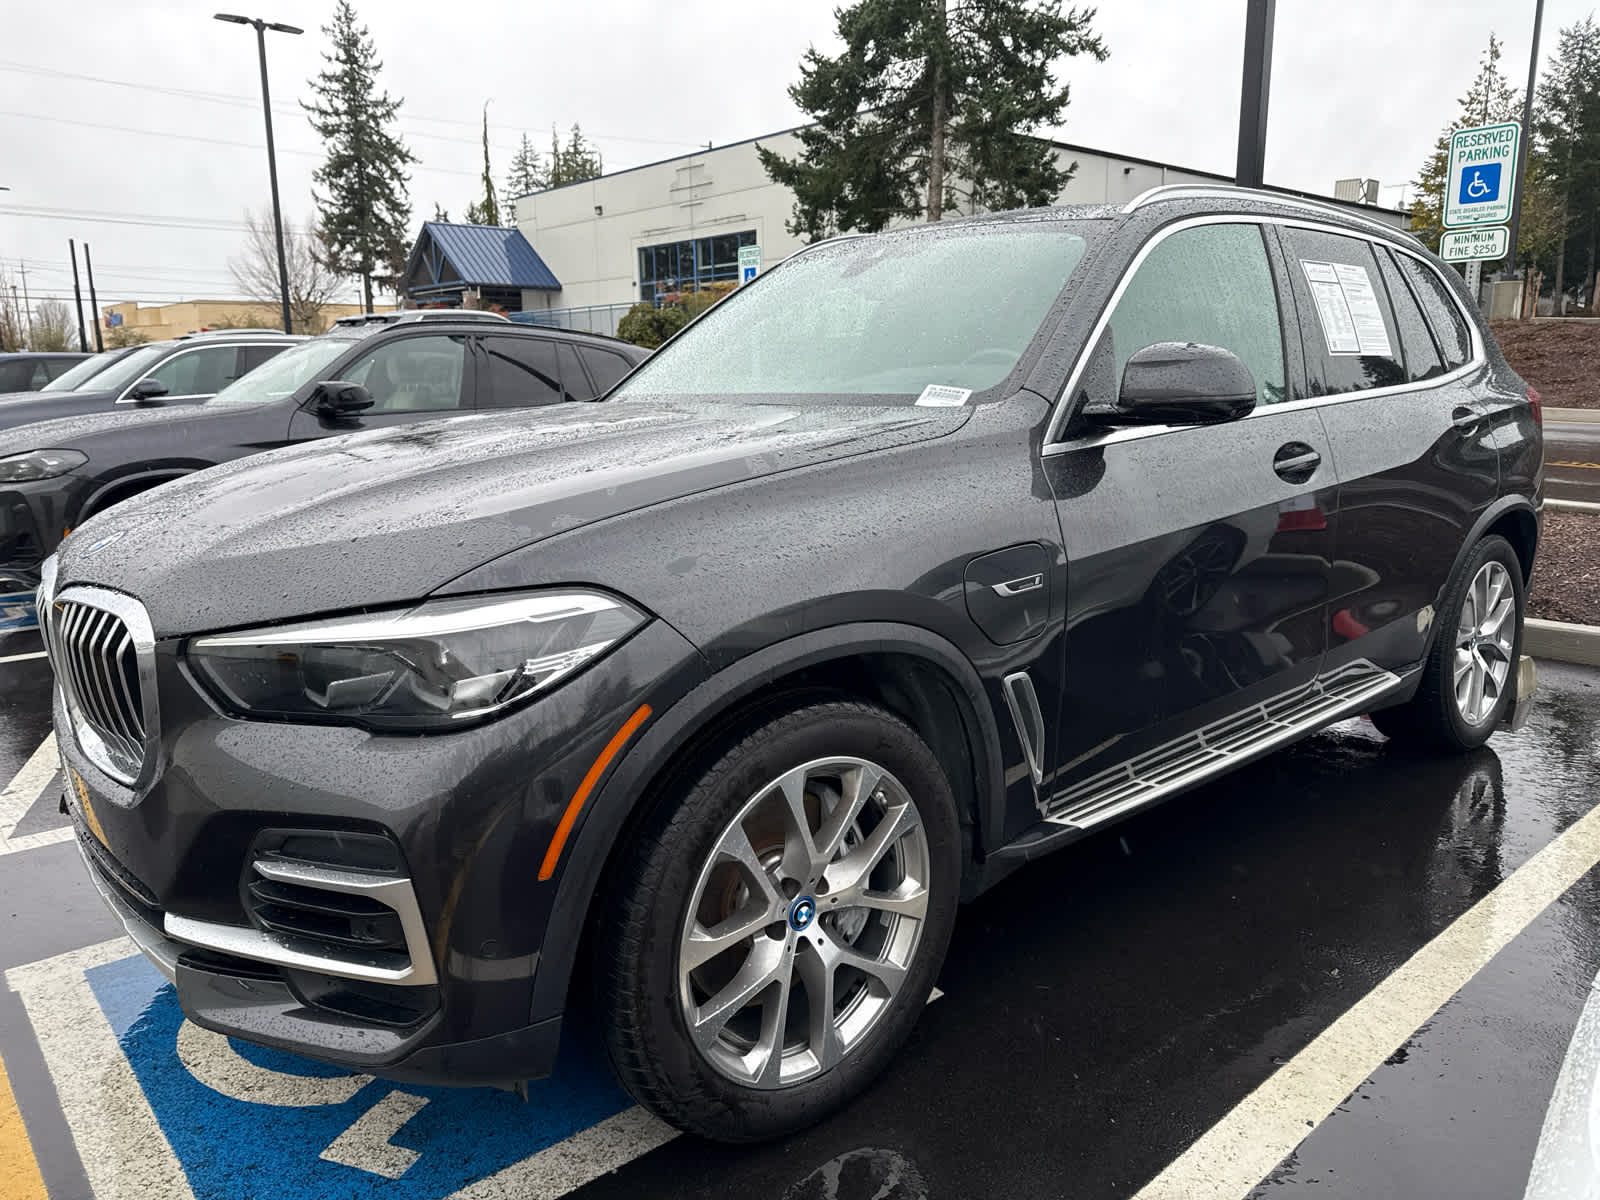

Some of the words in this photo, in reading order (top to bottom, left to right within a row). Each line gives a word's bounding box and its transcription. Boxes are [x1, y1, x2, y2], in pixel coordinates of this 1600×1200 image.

[1456, 129, 1514, 149] RESERVED
[1458, 145, 1510, 163] PARKING
[1454, 232, 1495, 245] MINIMUM
[1449, 246, 1470, 257] FINE
[1473, 244, 1497, 256] $250
